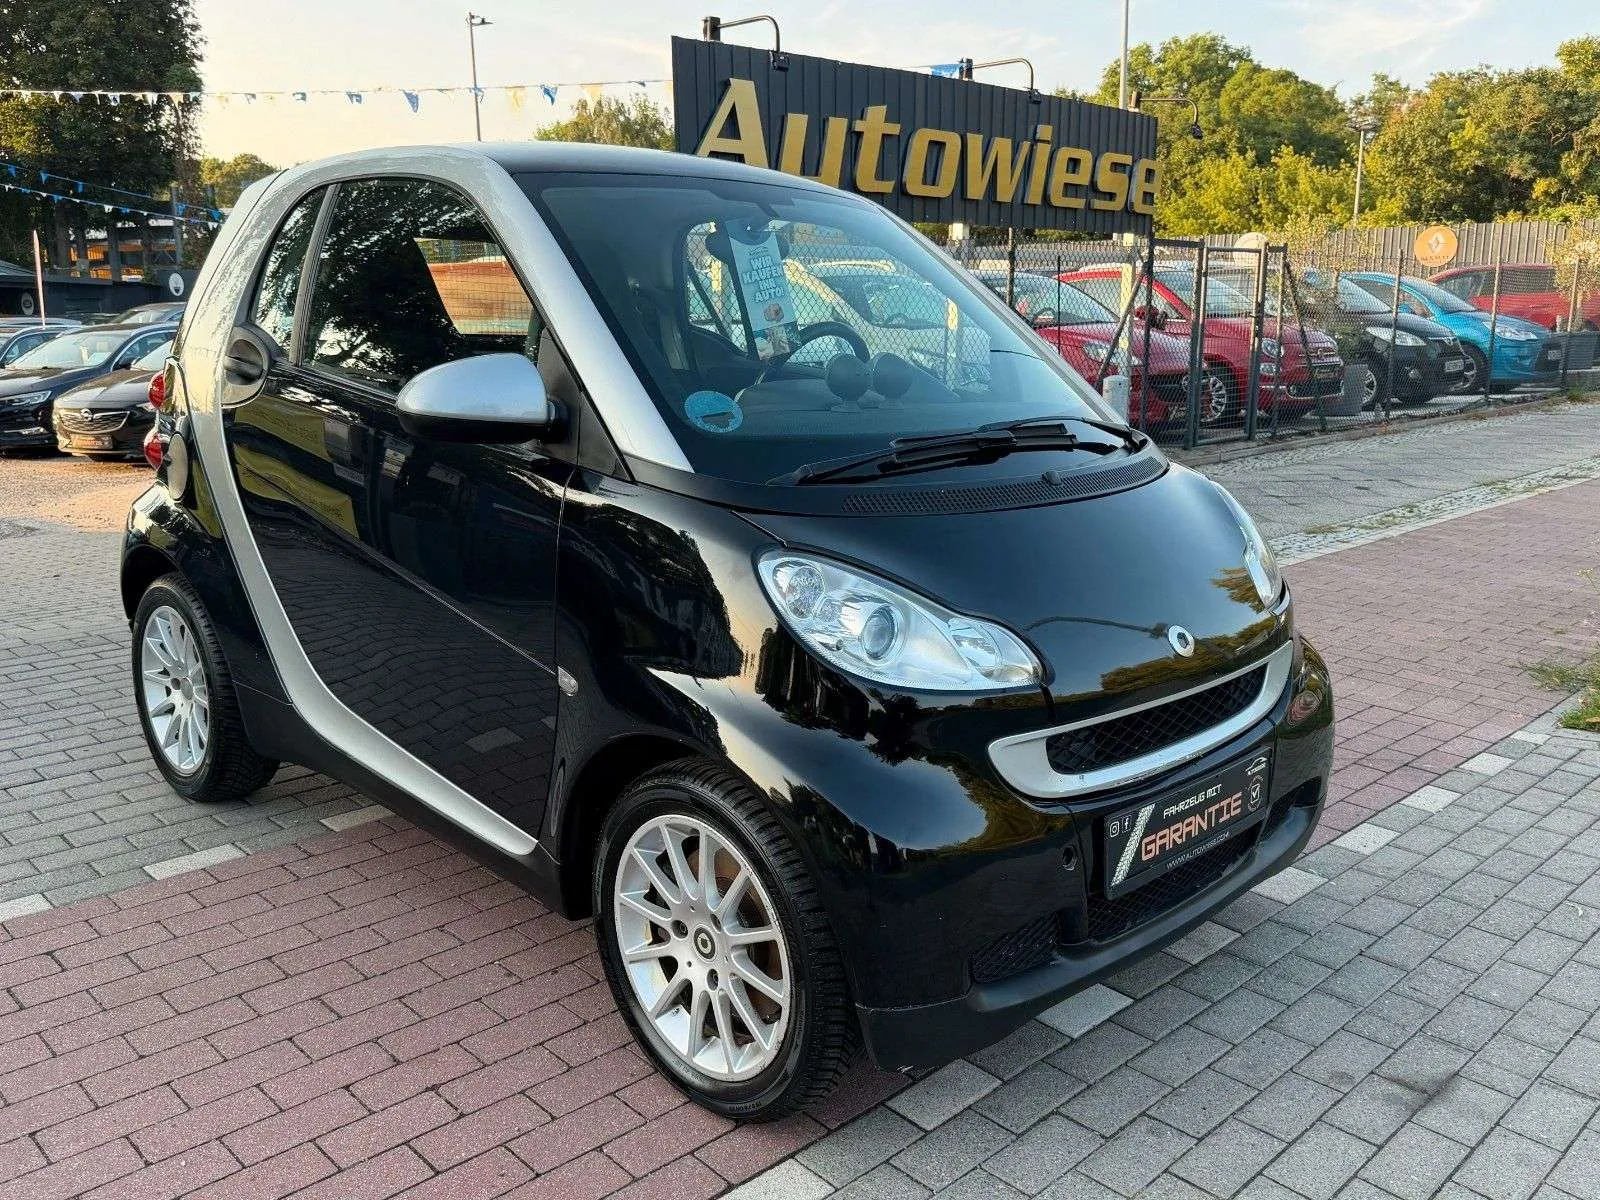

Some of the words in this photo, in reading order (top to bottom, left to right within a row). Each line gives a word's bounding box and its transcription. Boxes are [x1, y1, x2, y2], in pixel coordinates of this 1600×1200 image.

[695, 78, 1162, 214] Autowiese
[742, 264, 784, 284] KAUFEN
[750, 256, 773, 270] WIR
[755, 286, 785, 302] AUTO!
[1163, 790, 1205, 819] FAHRZEUG
[1206, 783, 1223, 799] MIT
[1141, 791, 1243, 862] GARANTIE
